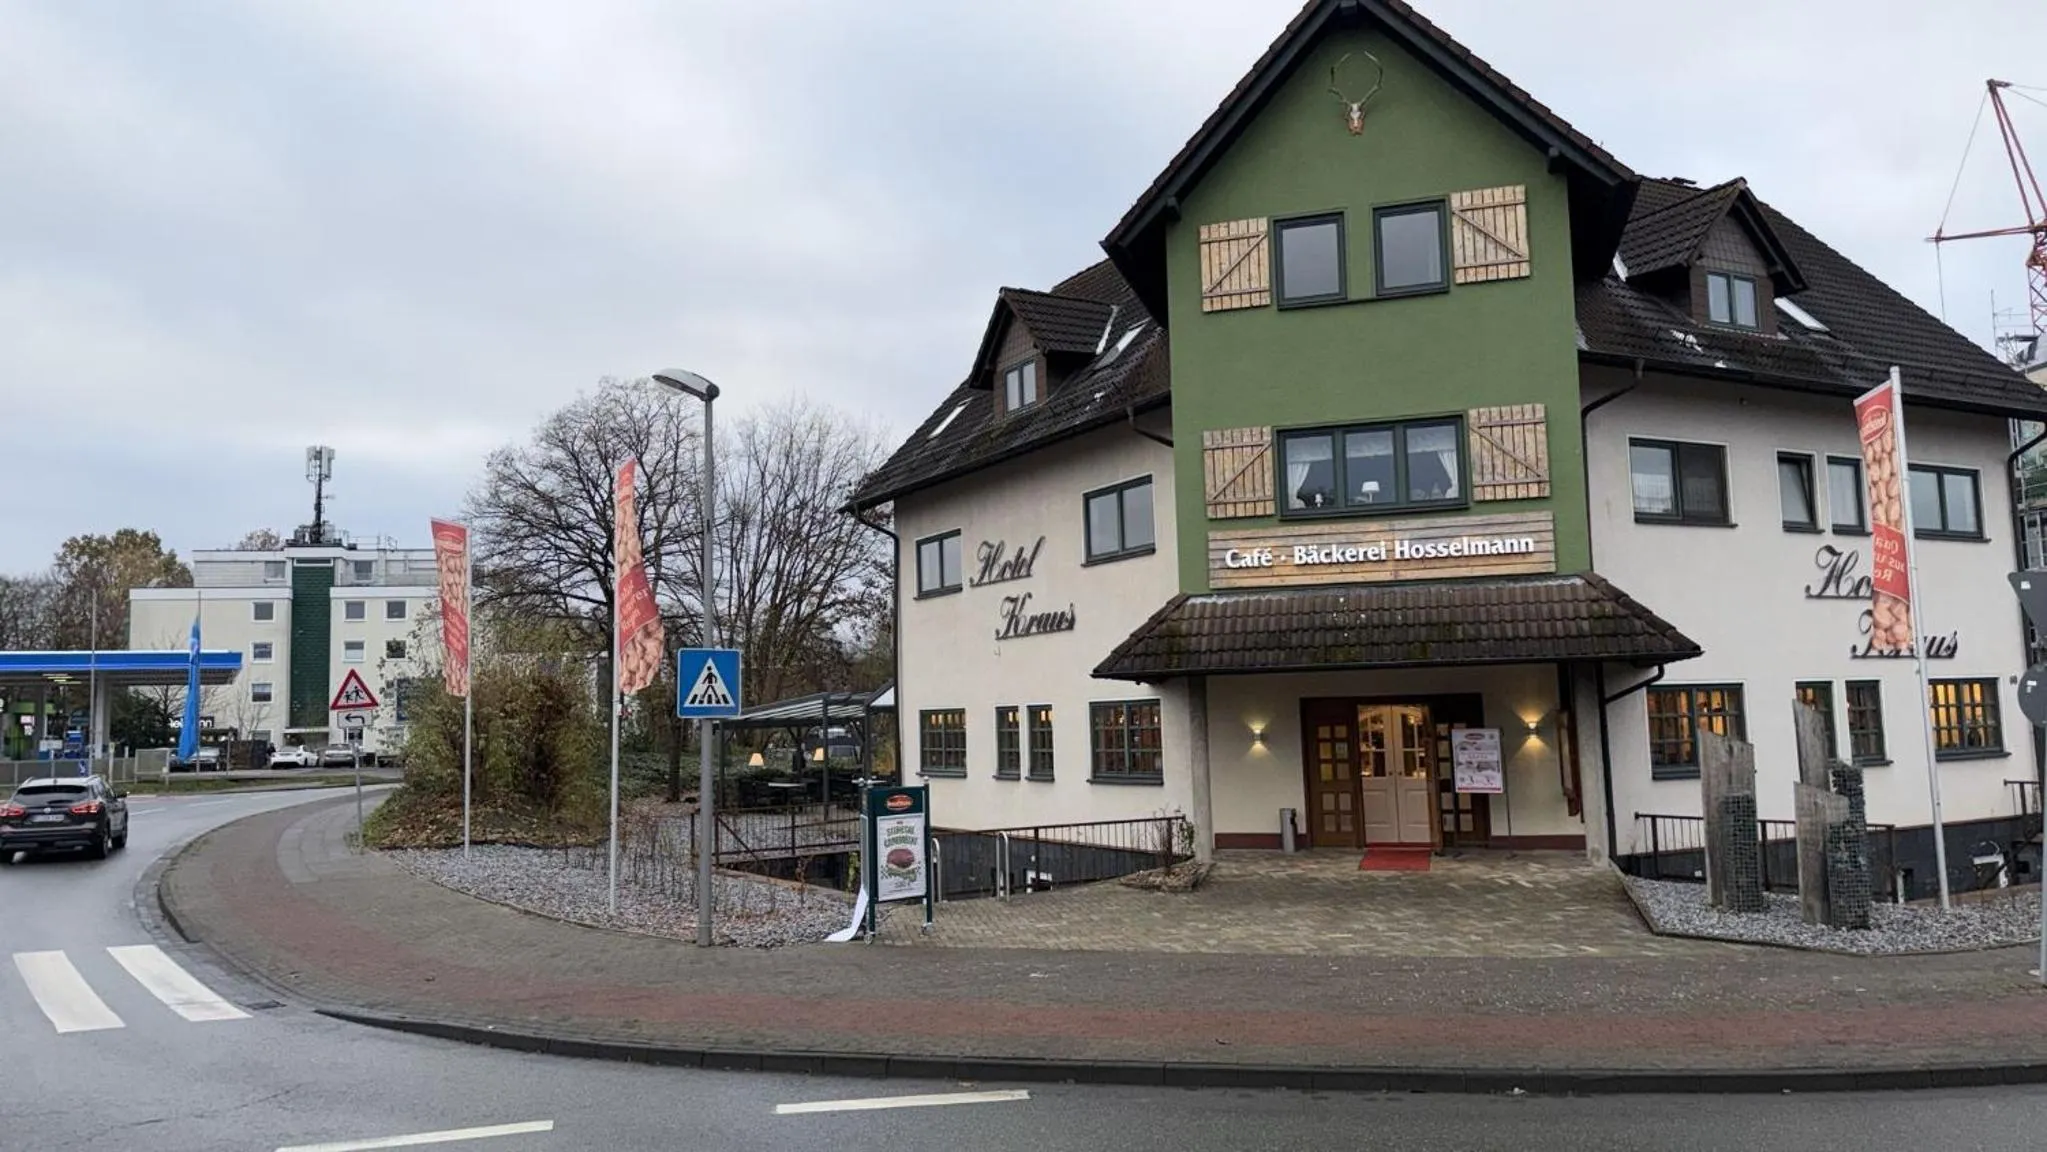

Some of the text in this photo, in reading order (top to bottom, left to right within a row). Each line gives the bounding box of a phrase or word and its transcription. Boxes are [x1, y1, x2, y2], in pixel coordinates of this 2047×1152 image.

[969, 535, 1046, 588] Hotel
[1225, 536, 1535, 569] Café Bäckerei Hosselmann
[994, 591, 1076, 641] Kraus
